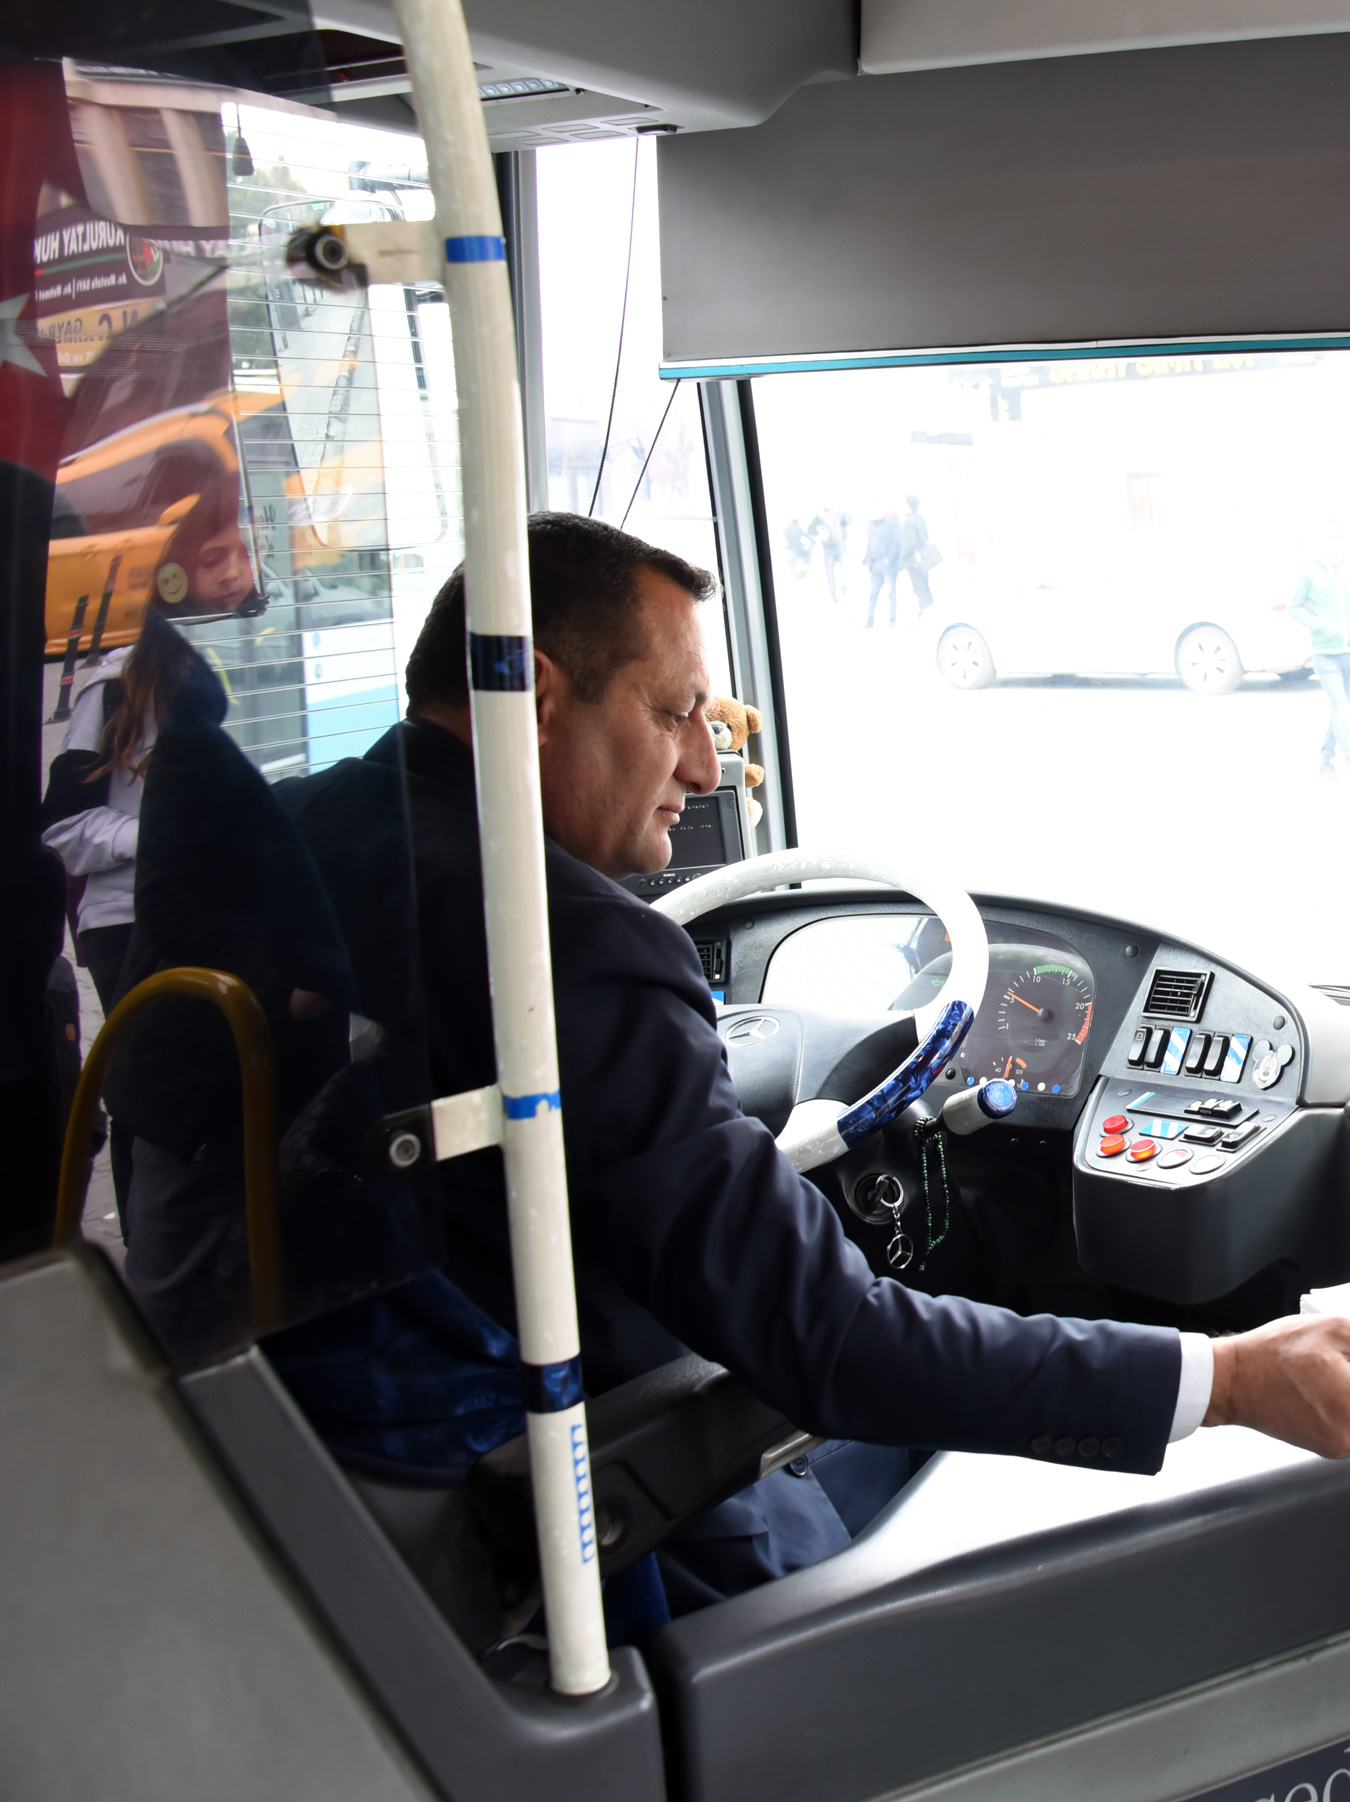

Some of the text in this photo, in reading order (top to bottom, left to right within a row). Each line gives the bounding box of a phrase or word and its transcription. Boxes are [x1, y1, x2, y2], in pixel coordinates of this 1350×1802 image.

[1032, 975, 1042, 983] 10
[1062, 978, 1071, 986] 15
[1009, 996, 1015, 1004] 5
[1075, 1002, 1085, 1010] 20
[1067, 1032, 1076, 1040] 25
